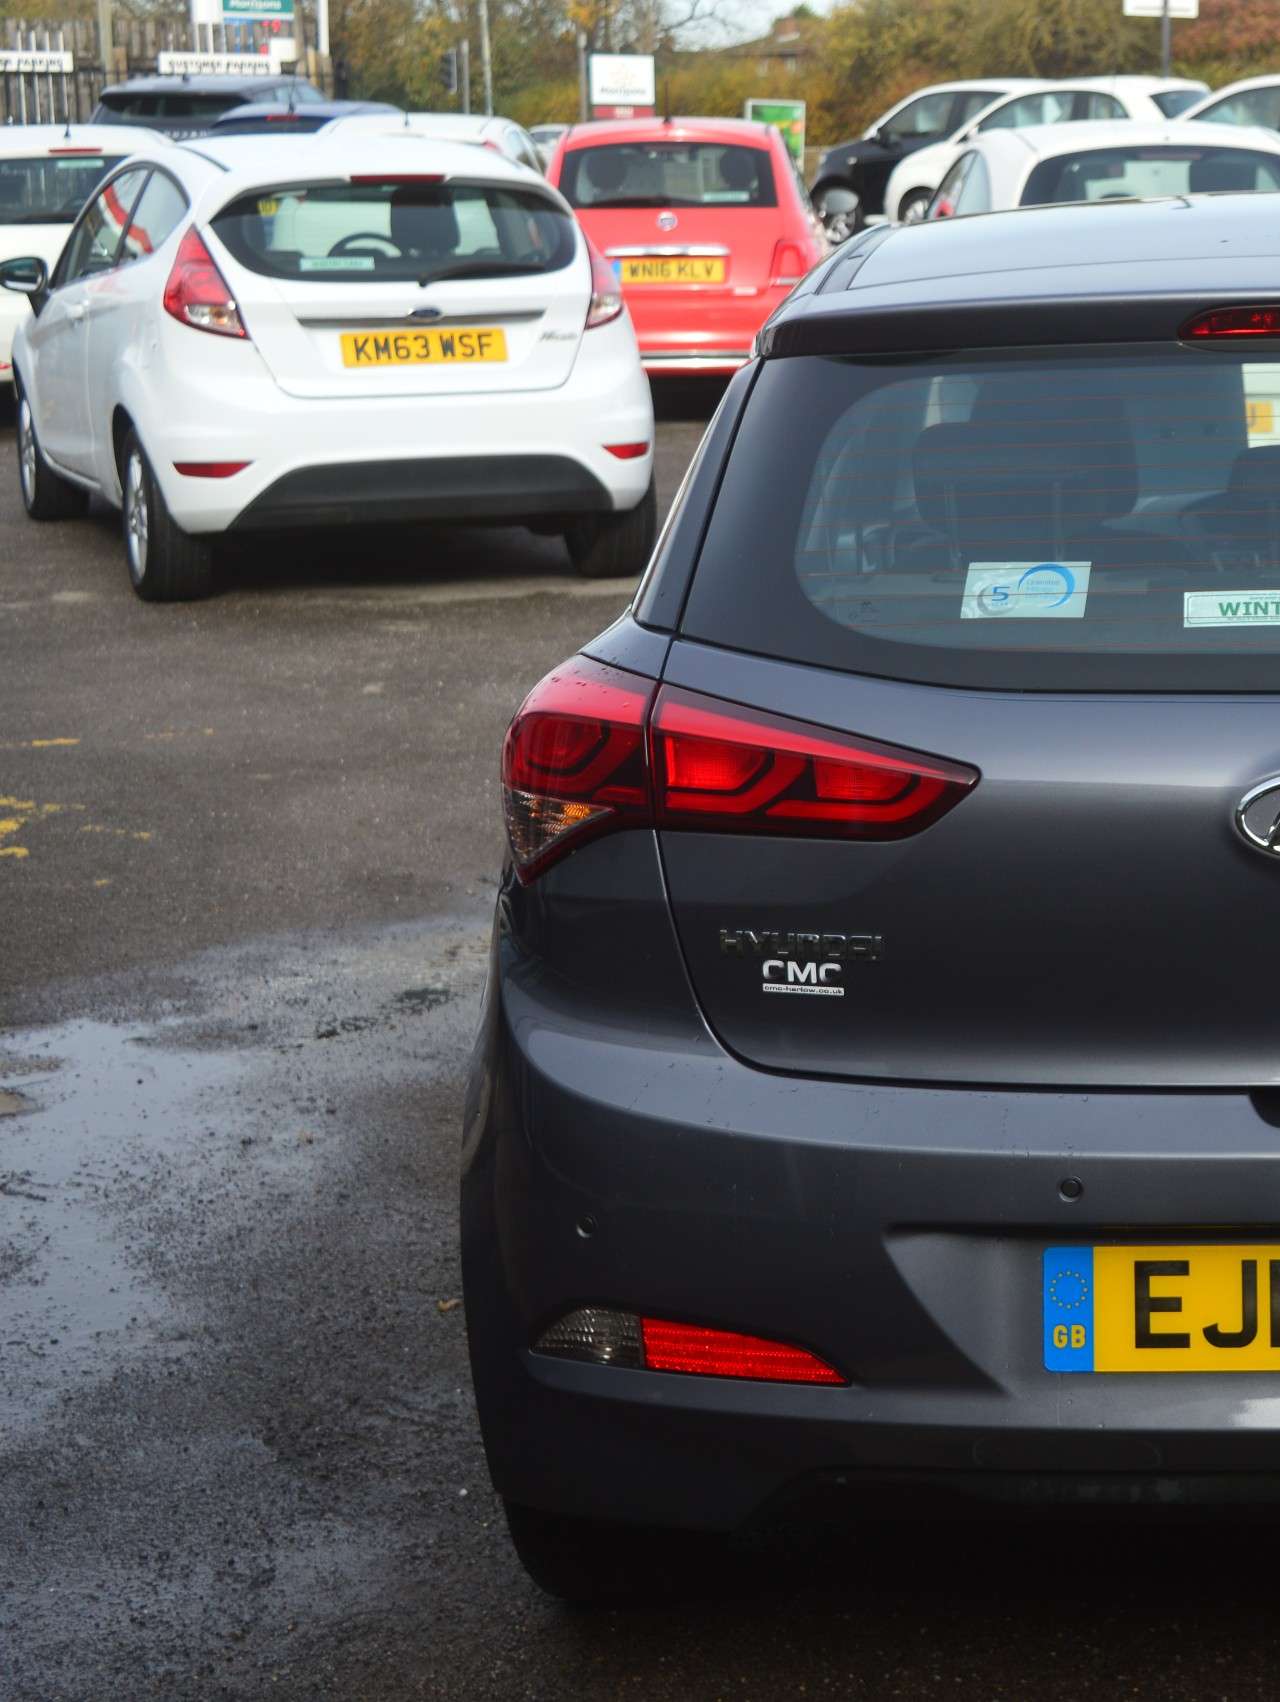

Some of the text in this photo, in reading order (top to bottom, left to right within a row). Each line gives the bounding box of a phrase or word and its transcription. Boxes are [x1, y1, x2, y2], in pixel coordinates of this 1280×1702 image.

[629, 262, 671, 278] WN16
[353, 332, 493, 362] KM63 WSF
[991, 586, 1011, 601] 5
[762, 959, 842, 984] CMC
[763, 984, 844, 996] cmc-harlow.co.uk
[1053, 1324, 1086, 1349] GB
